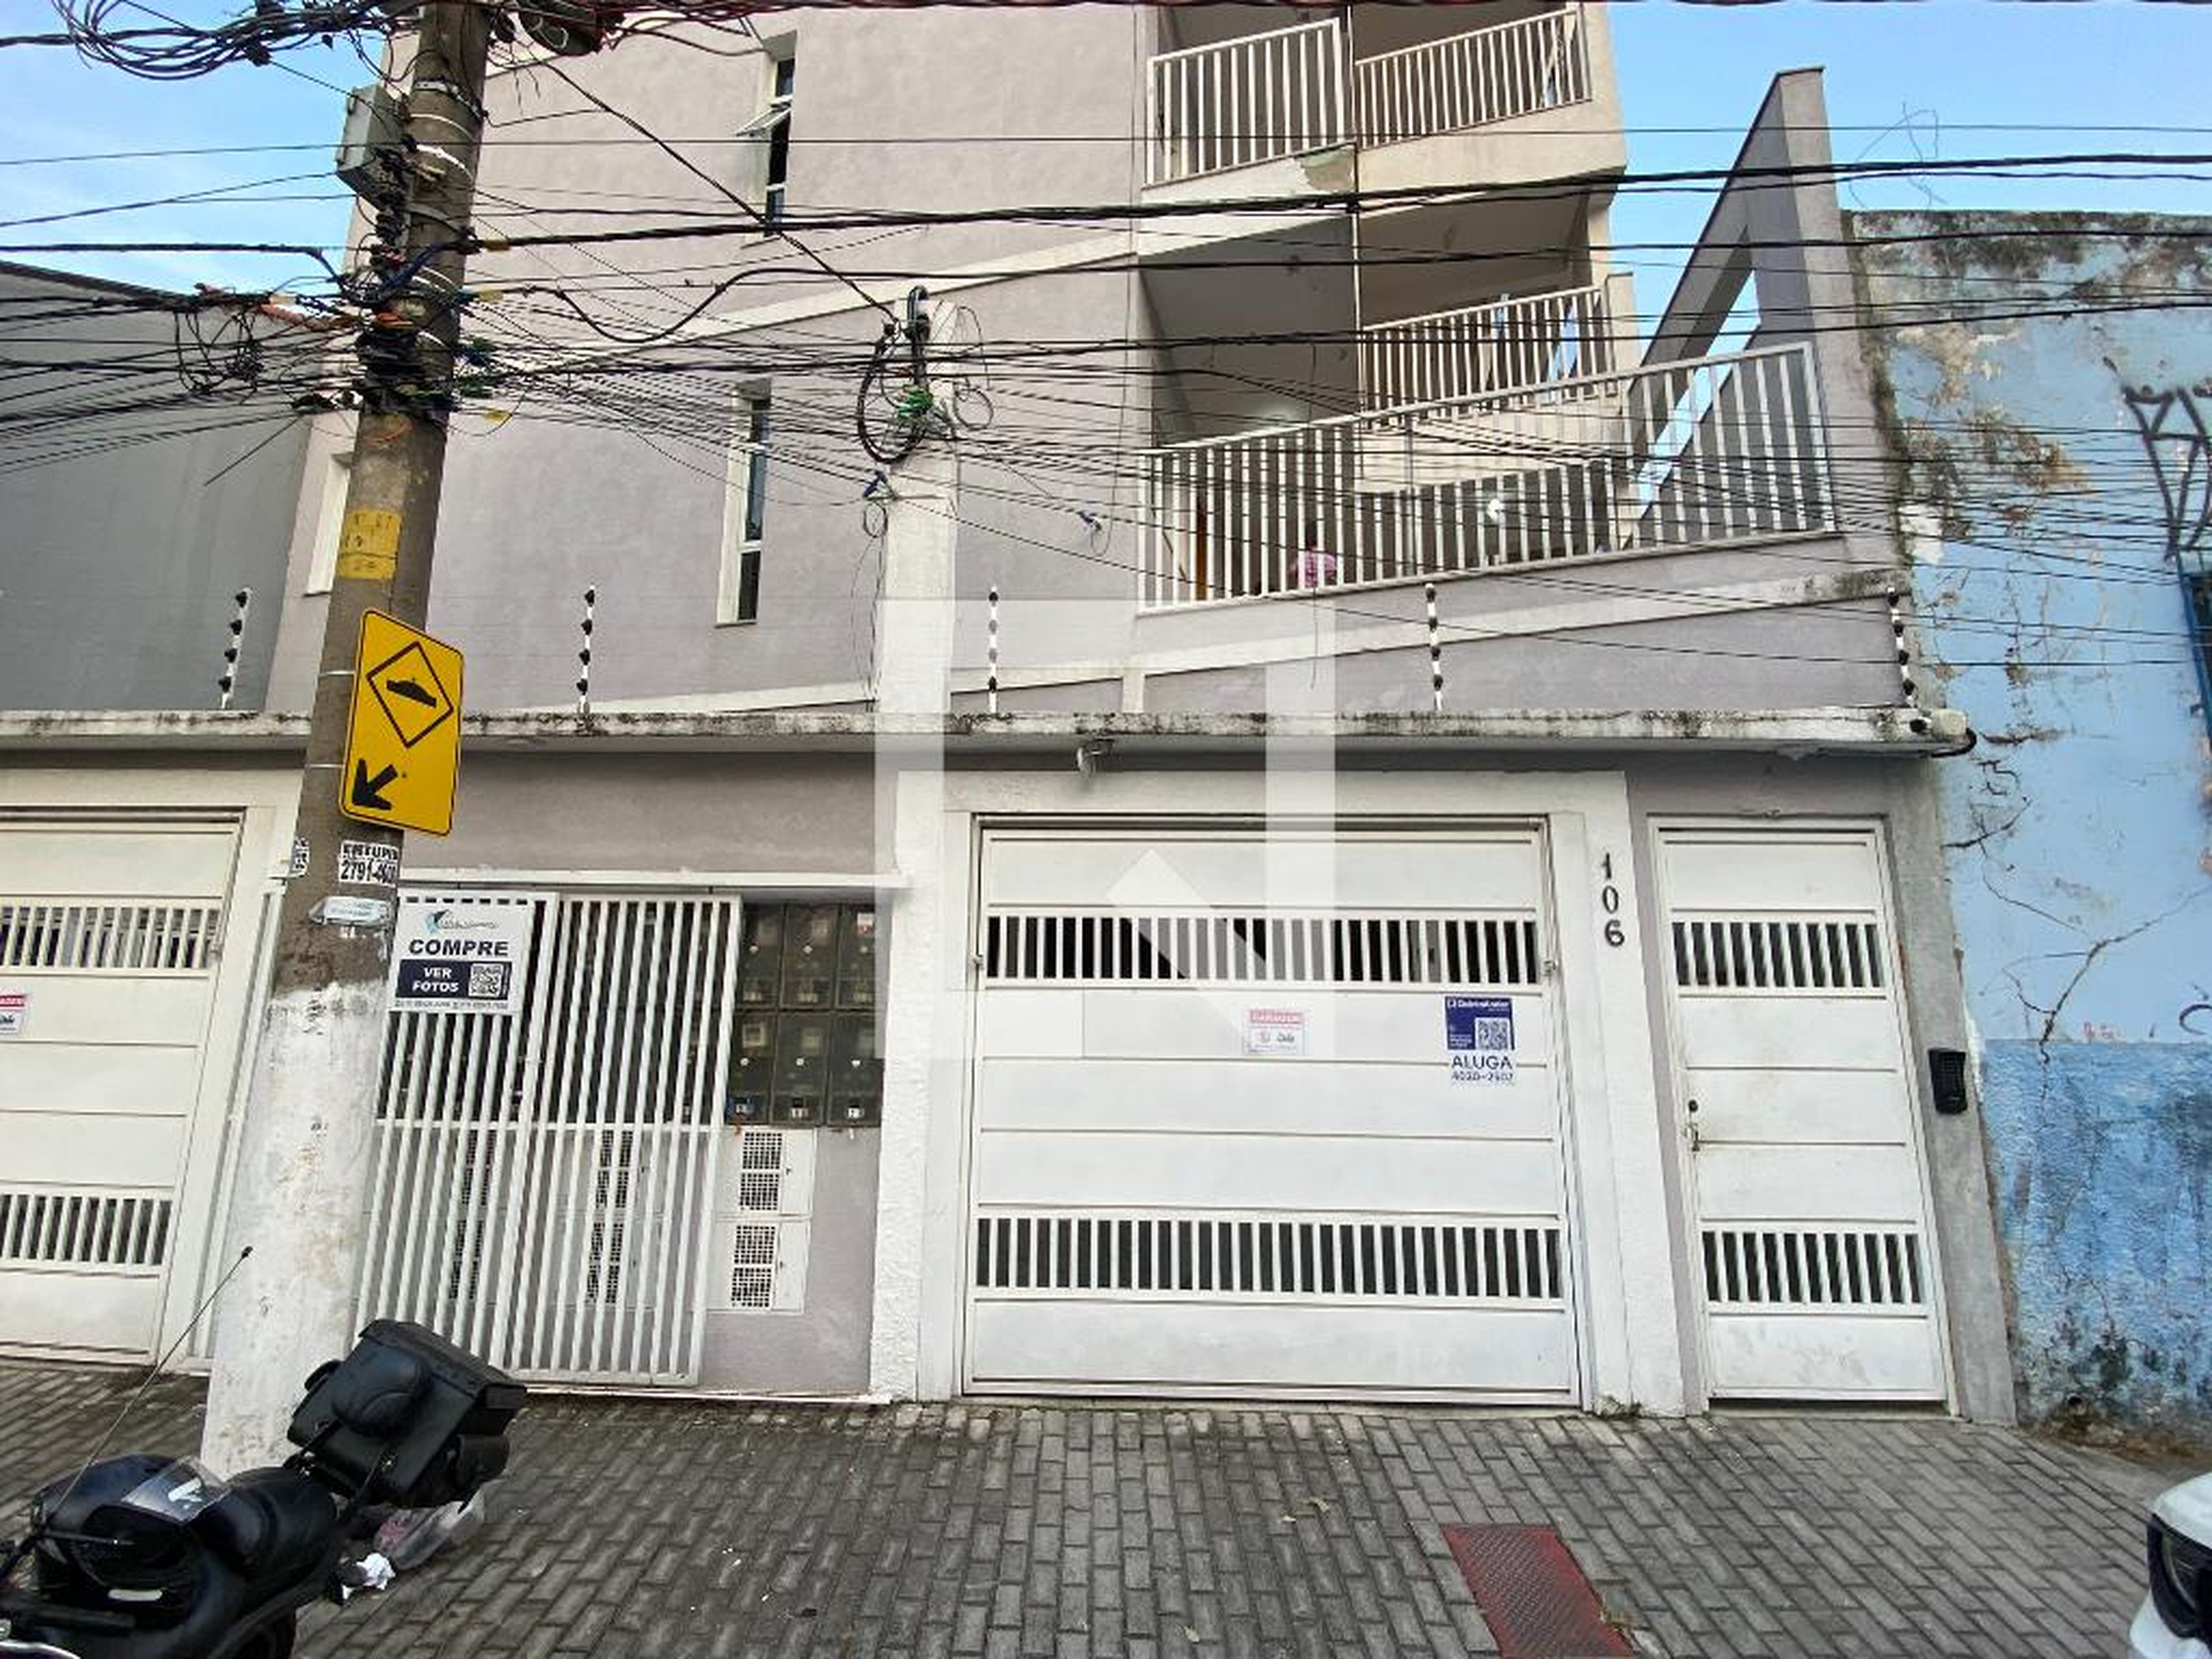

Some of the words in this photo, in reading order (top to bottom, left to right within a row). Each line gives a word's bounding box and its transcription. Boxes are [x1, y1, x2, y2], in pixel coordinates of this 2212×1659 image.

[1601, 852, 1625, 948] 106
[408, 939, 509, 956] COMPRE
[424, 967, 452, 979] VER
[412, 980, 459, 993] FOTOS
[1452, 1055, 1513, 1070] ALUGA
